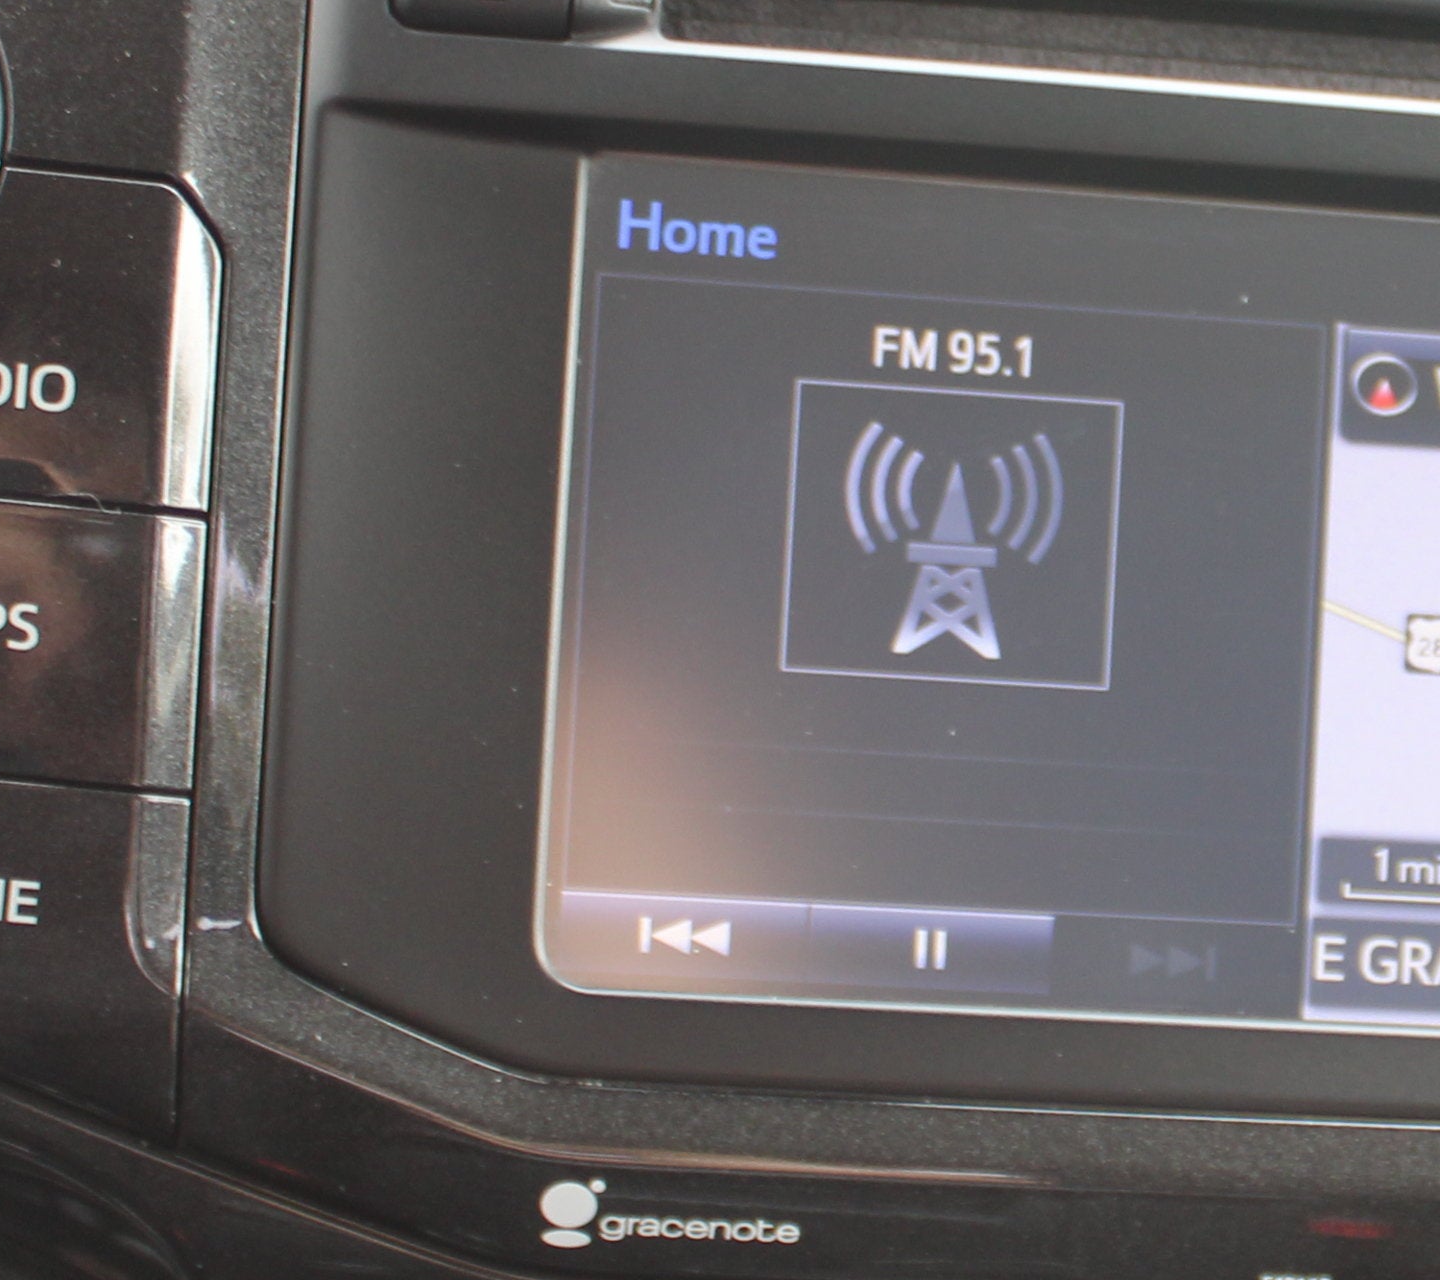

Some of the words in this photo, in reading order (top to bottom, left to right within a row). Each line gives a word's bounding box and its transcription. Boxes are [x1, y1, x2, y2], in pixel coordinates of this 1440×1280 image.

[617, 198, 779, 261] Home
[872, 324, 939, 372] FM
[947, 328, 1034, 379] 95.1
[1372, 847, 1391, 883] 1
[1312, 934, 1348, 983] E
[598, 1215, 802, 1245] gracenote
